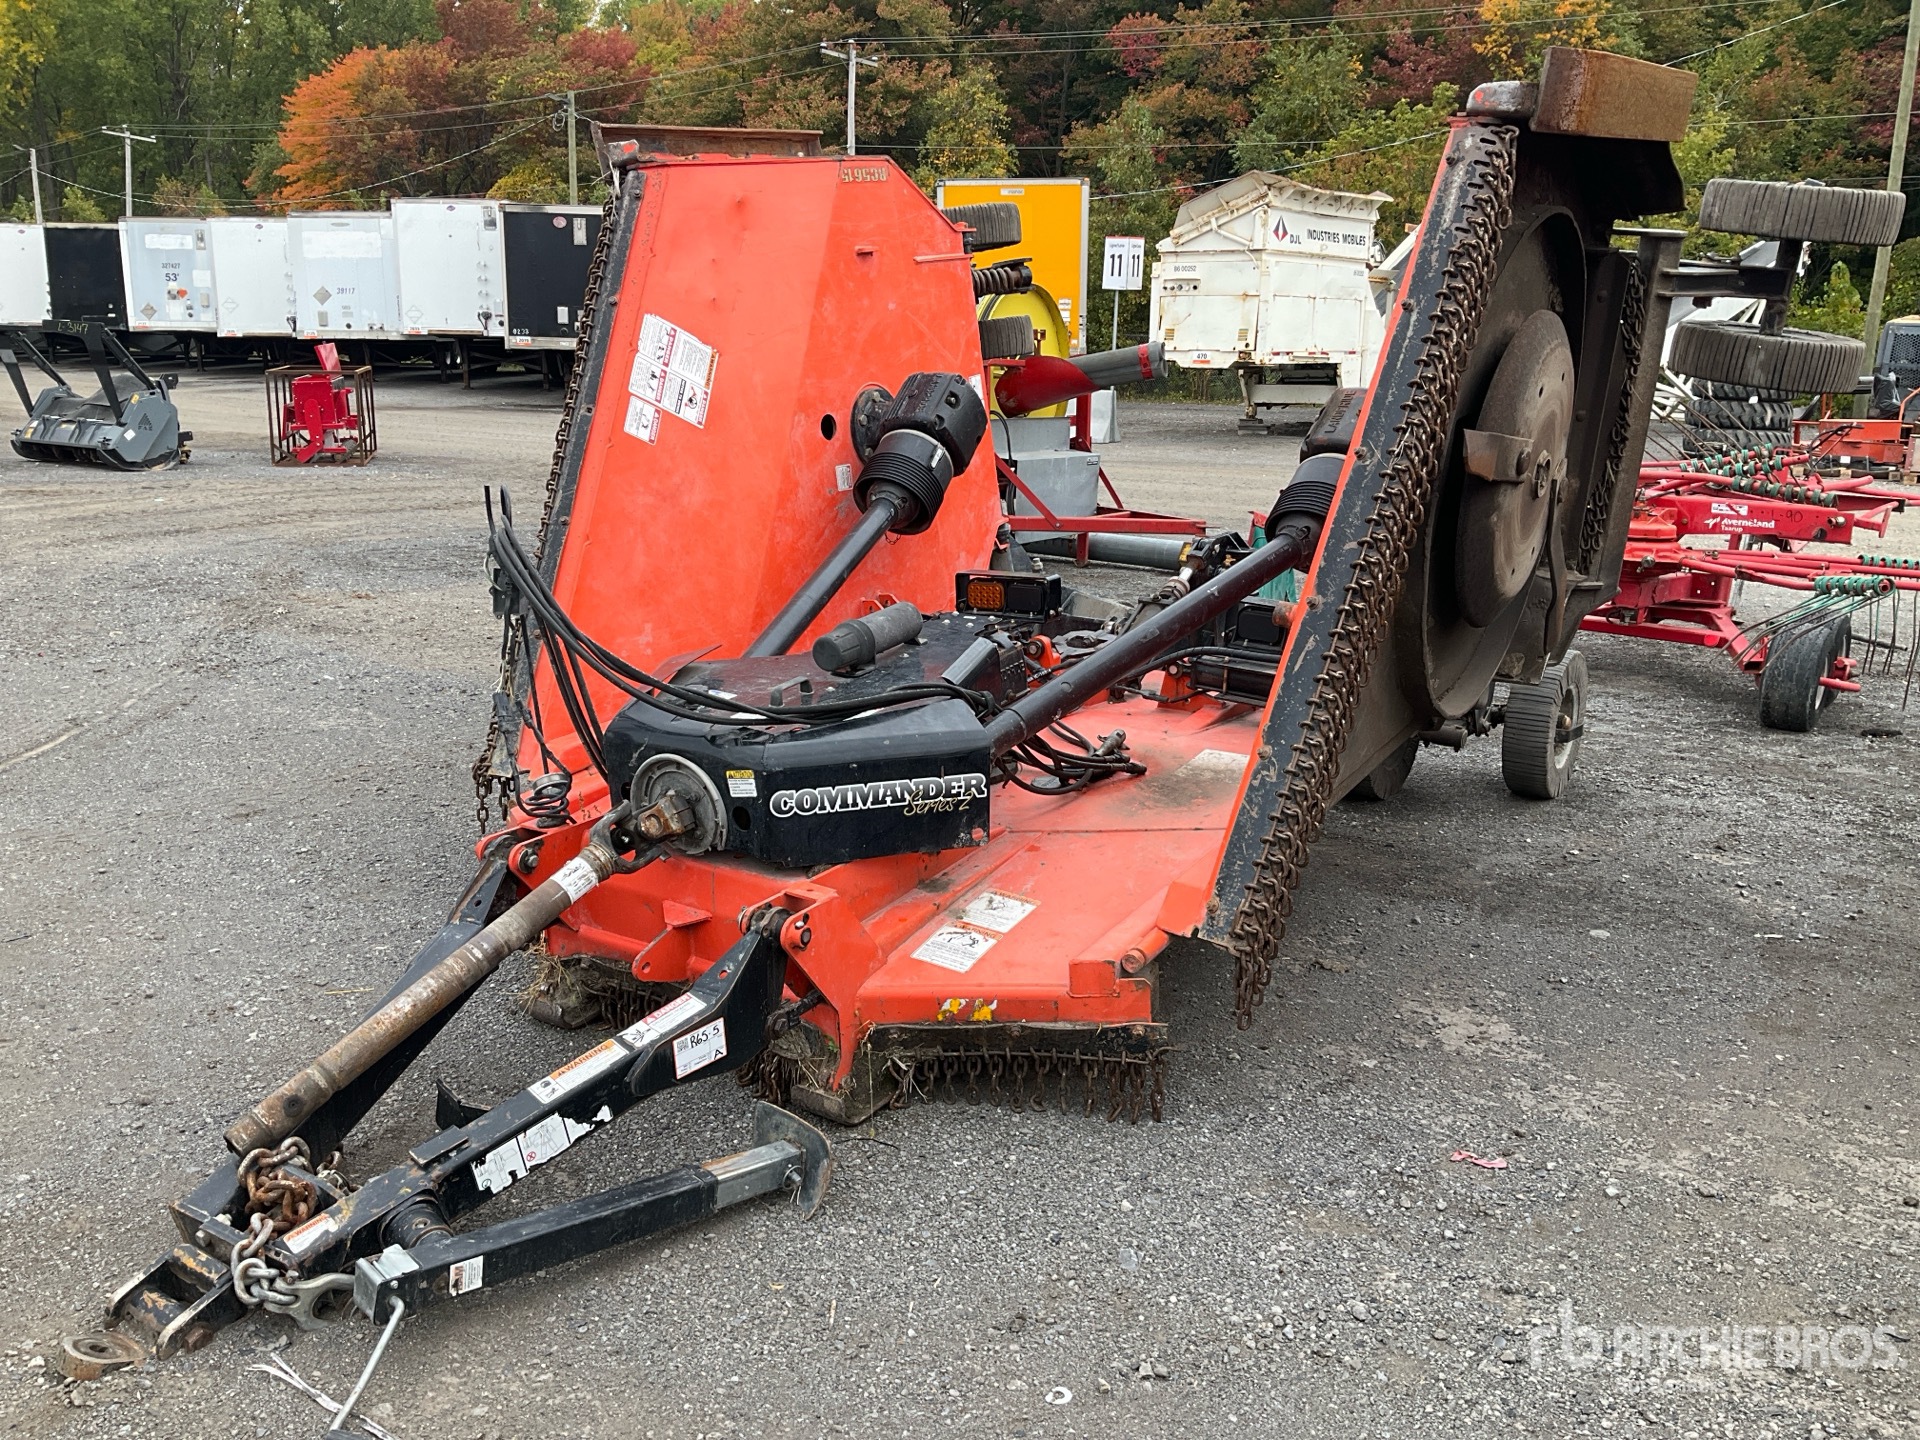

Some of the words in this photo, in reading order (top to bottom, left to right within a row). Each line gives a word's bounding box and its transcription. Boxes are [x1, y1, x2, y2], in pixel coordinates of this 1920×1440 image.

[1289, 233, 1302, 245] DJL
[1306, 229, 1340, 244] INDUSTRIES
[1341, 233, 1367, 247] MOBILES
[1109, 253, 1123, 277] 11
[1131, 253, 1140, 278] 11
[770, 773, 987, 818] COMMANDER
[903, 789, 954, 816] Series
[958, 790, 974, 811] 2
[654, 994, 691, 1019] DANGER
[563, 1044, 608, 1072] WARNING
